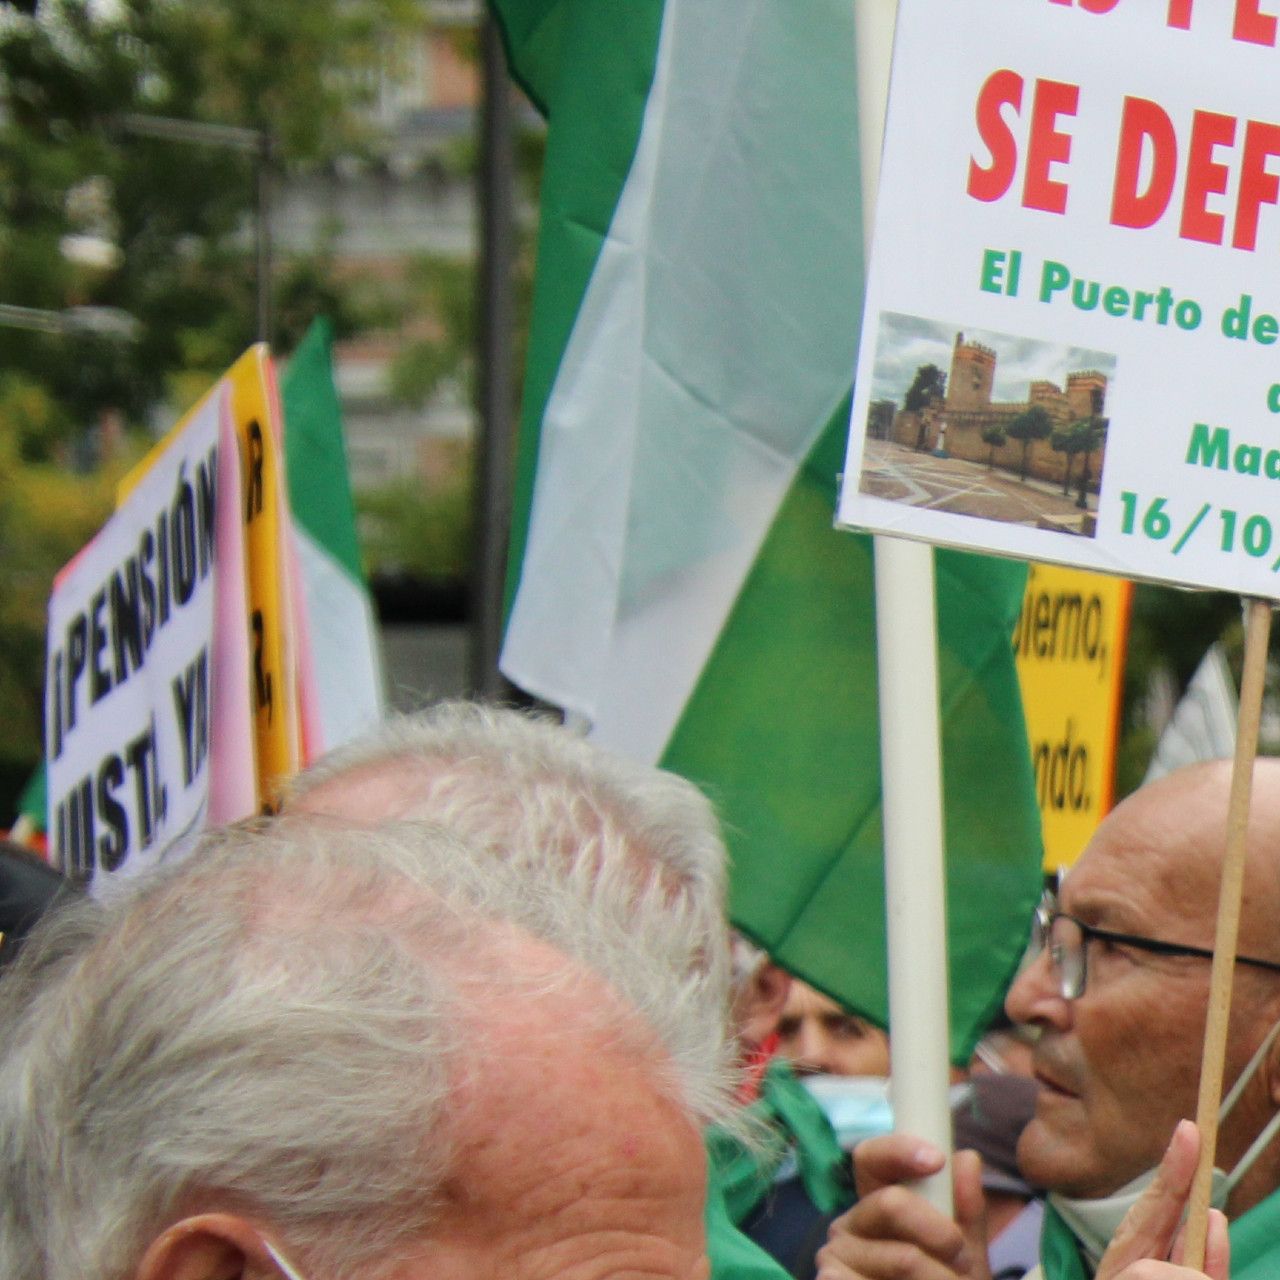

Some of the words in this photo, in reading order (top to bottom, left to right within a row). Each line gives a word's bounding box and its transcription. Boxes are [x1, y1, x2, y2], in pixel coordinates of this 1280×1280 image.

[967, 69, 1080, 215] SE
[980, 249, 1020, 297] El
[1039, 260, 1201, 331] Puerto
[1221, 295, 1279, 345] de
[1012, 566, 1107, 682] ierno,
